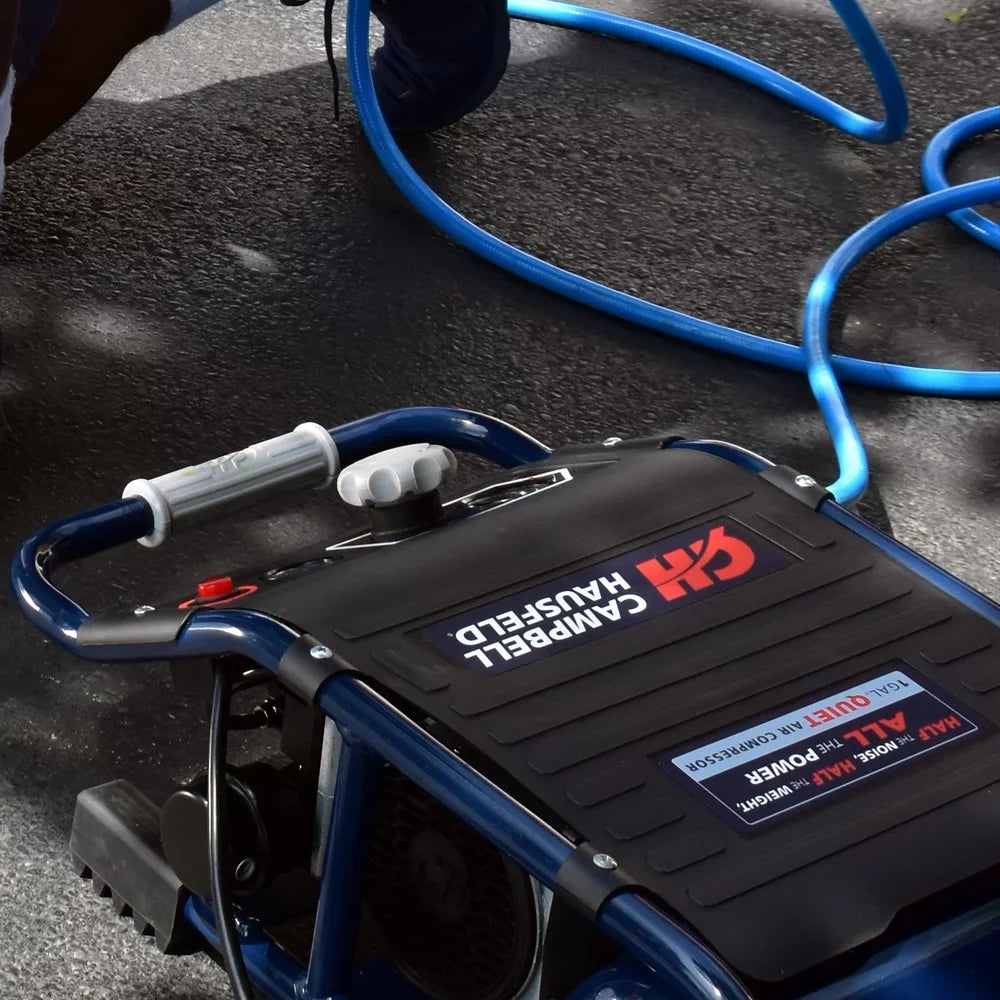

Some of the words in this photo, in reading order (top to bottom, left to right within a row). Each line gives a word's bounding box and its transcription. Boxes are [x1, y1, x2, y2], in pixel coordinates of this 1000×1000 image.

[455, 571, 632, 646] HAUSFELD
[464, 593, 648, 668] CAMPBELL
[803, 693, 871, 728] QUIET
[777, 721, 803, 736] AIR
[843, 711, 907, 746] ALL
[898, 733, 916, 746] THE
[918, 715, 961, 741] HALF
[685, 732, 778, 772] COMPRESSOR
[816, 738, 844, 754] THE
[853, 740, 899, 763] NOISE,
[744, 748, 820, 785] POWER
[812, 759, 857, 786] HALF
[792, 777, 810, 790] THE
[736, 785, 793, 813] WEIGHT,
